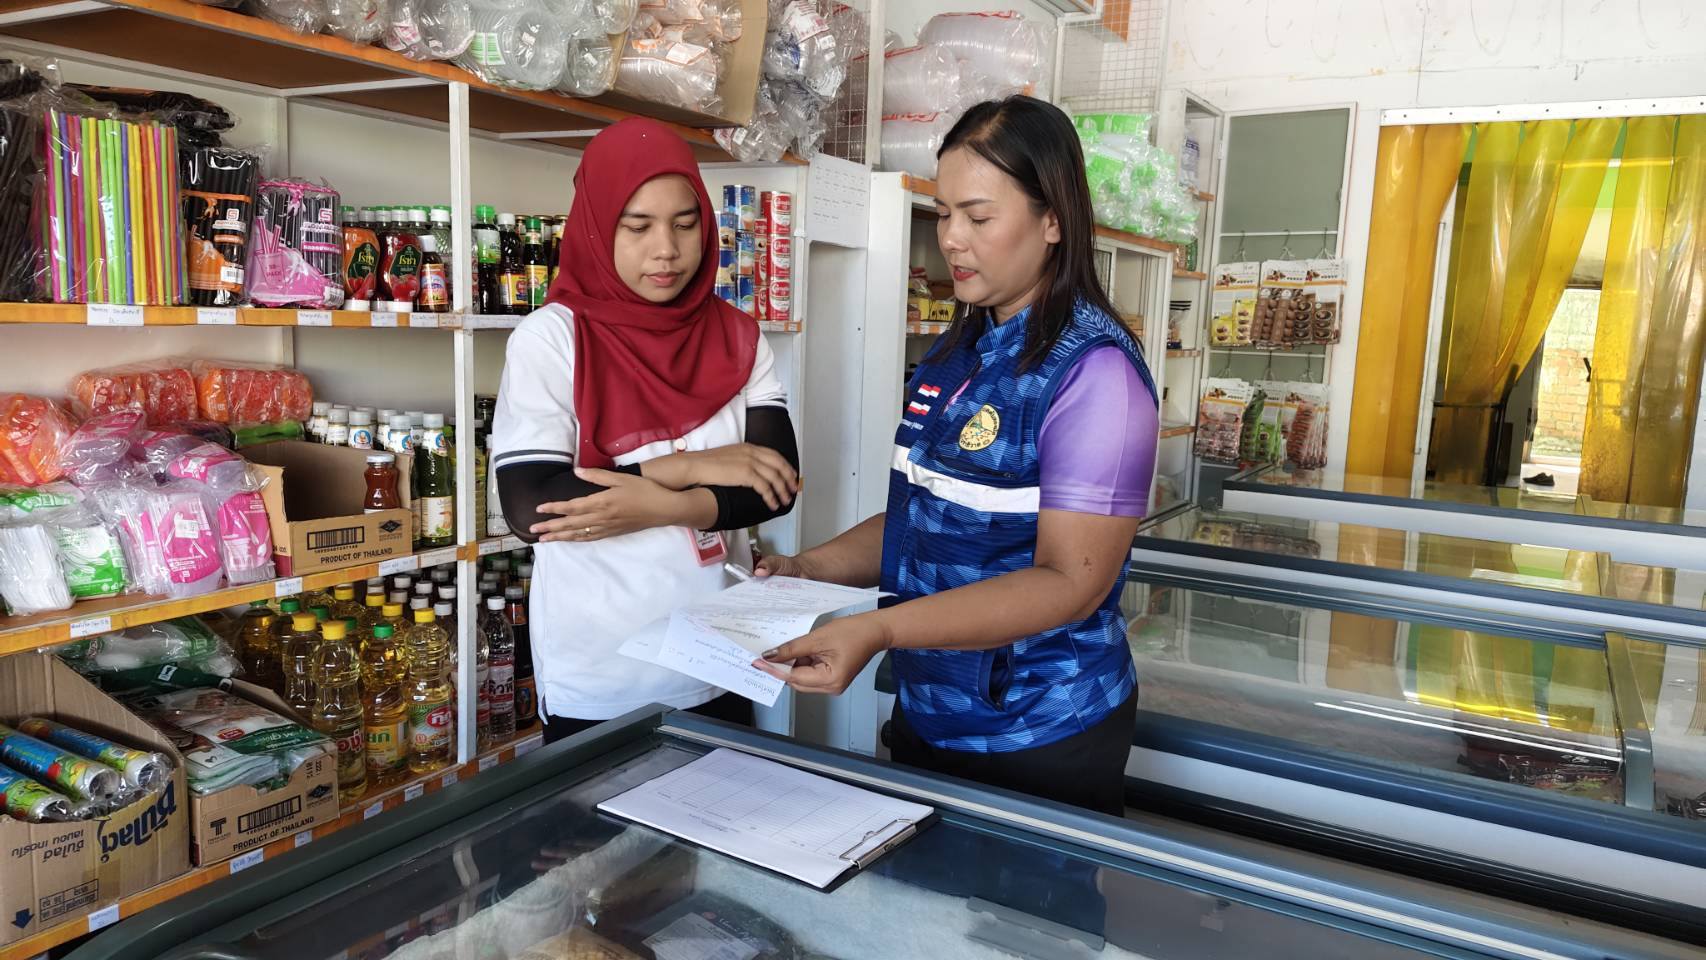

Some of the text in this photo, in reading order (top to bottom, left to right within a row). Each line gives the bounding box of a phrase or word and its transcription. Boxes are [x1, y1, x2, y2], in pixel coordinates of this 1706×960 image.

[320, 553, 351, 565] PRODUCT
[353, 551, 363, 560] OF
[364, 547, 394, 558] THAILAND
[233, 833, 268, 851] PRODUCT
[269, 828, 281, 839] OF
[281, 815, 314, 834] THAILAND
